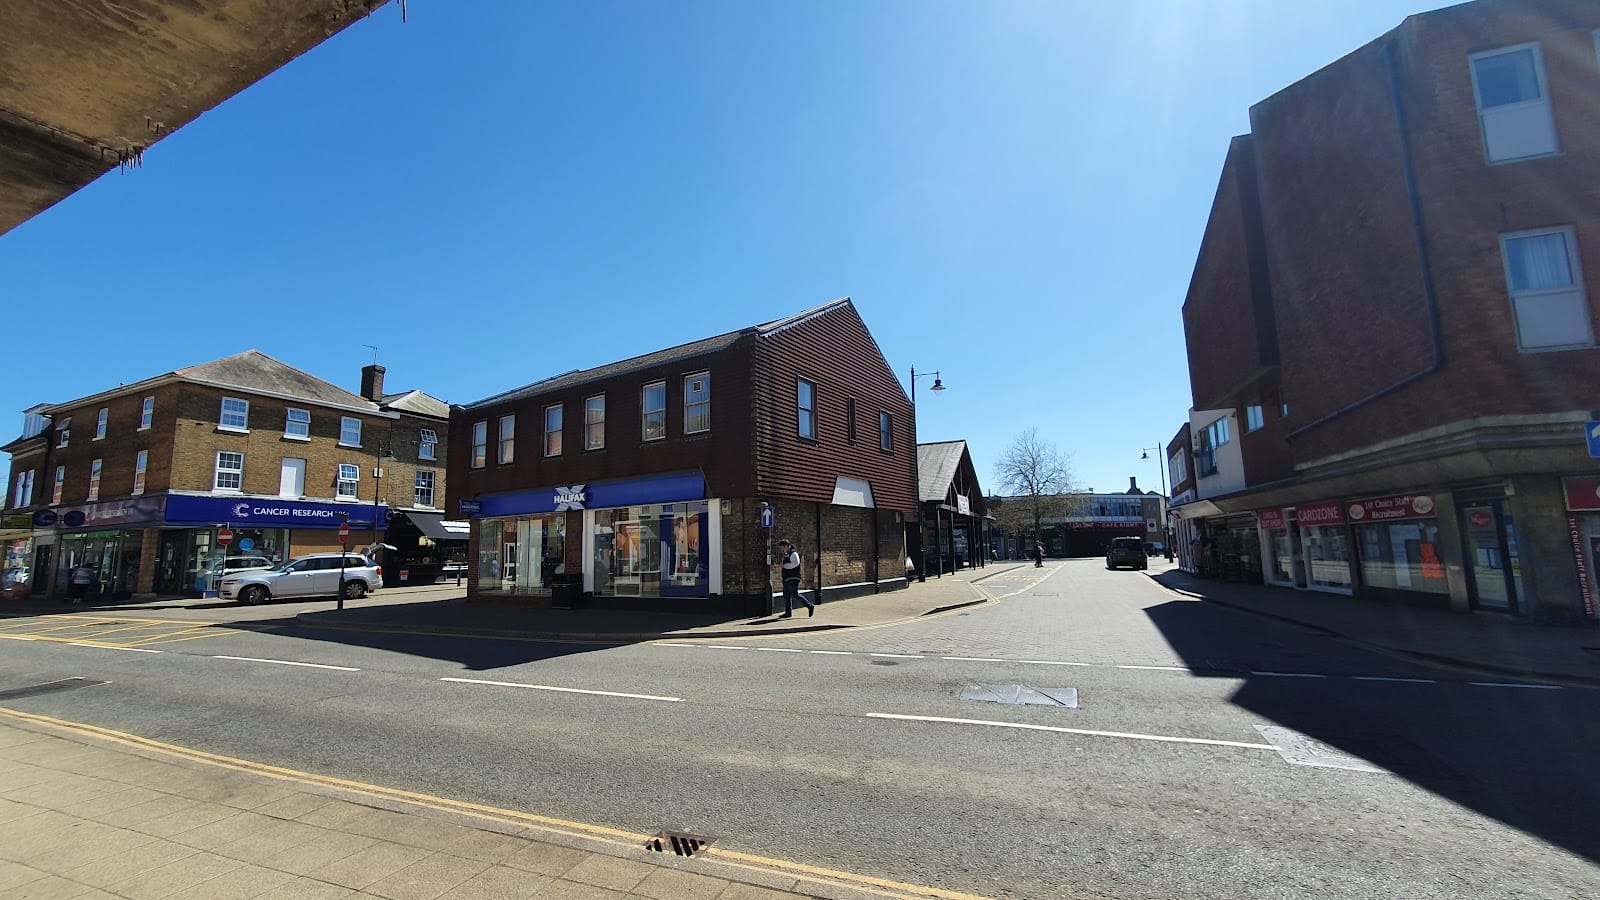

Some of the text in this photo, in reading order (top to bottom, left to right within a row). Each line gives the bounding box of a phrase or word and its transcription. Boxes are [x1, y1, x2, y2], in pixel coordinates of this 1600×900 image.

[553, 492, 586, 504] HALIFAX
[1364, 501, 1374, 510] 1st
[1374, 499, 1393, 509] Choice
[1394, 496, 1410, 507] Staff
[253, 507, 290, 516] CANCER
[292, 508, 334, 518] RESEARCH
[1299, 506, 1339, 522] CARDZONE
[1371, 508, 1406, 519] Recruitment
